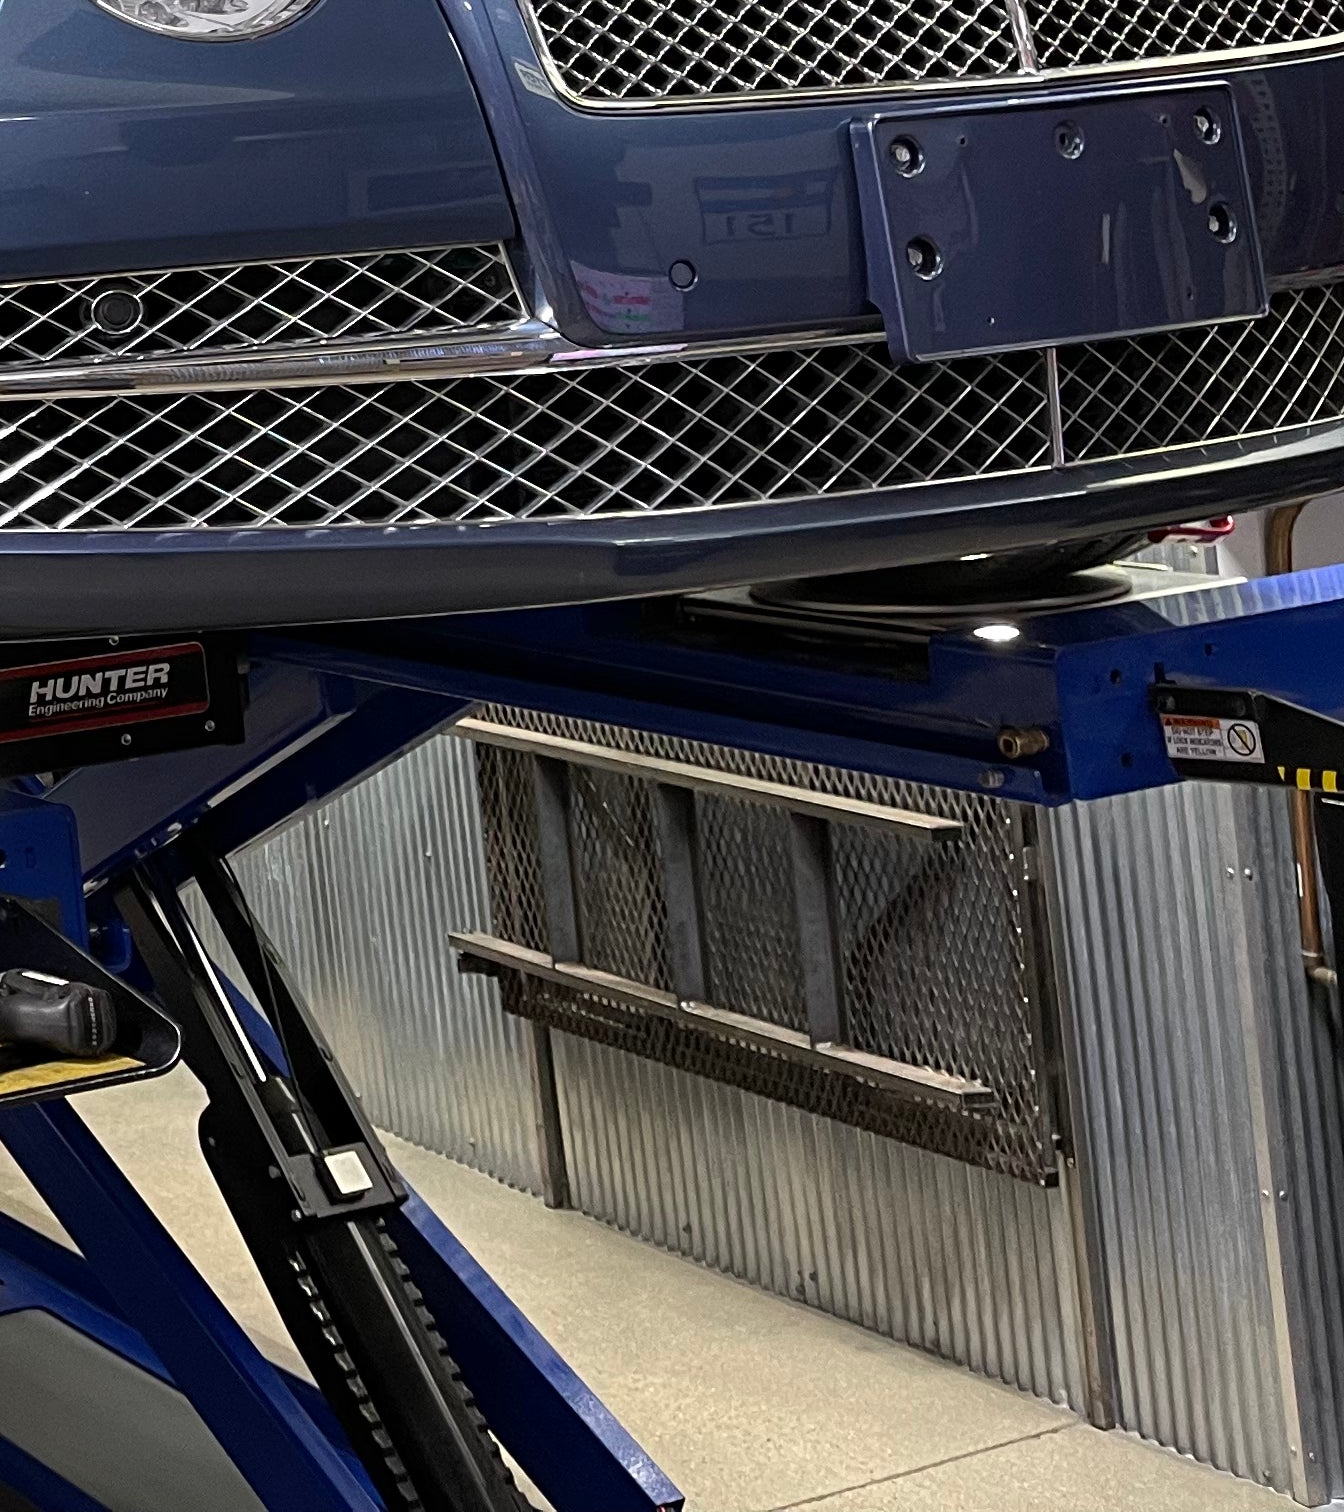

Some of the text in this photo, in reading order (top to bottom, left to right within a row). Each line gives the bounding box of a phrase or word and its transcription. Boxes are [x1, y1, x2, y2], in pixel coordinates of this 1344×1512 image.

[29, 662, 171, 704] HUNTER
[28, 687, 169, 717] Engineering Company
